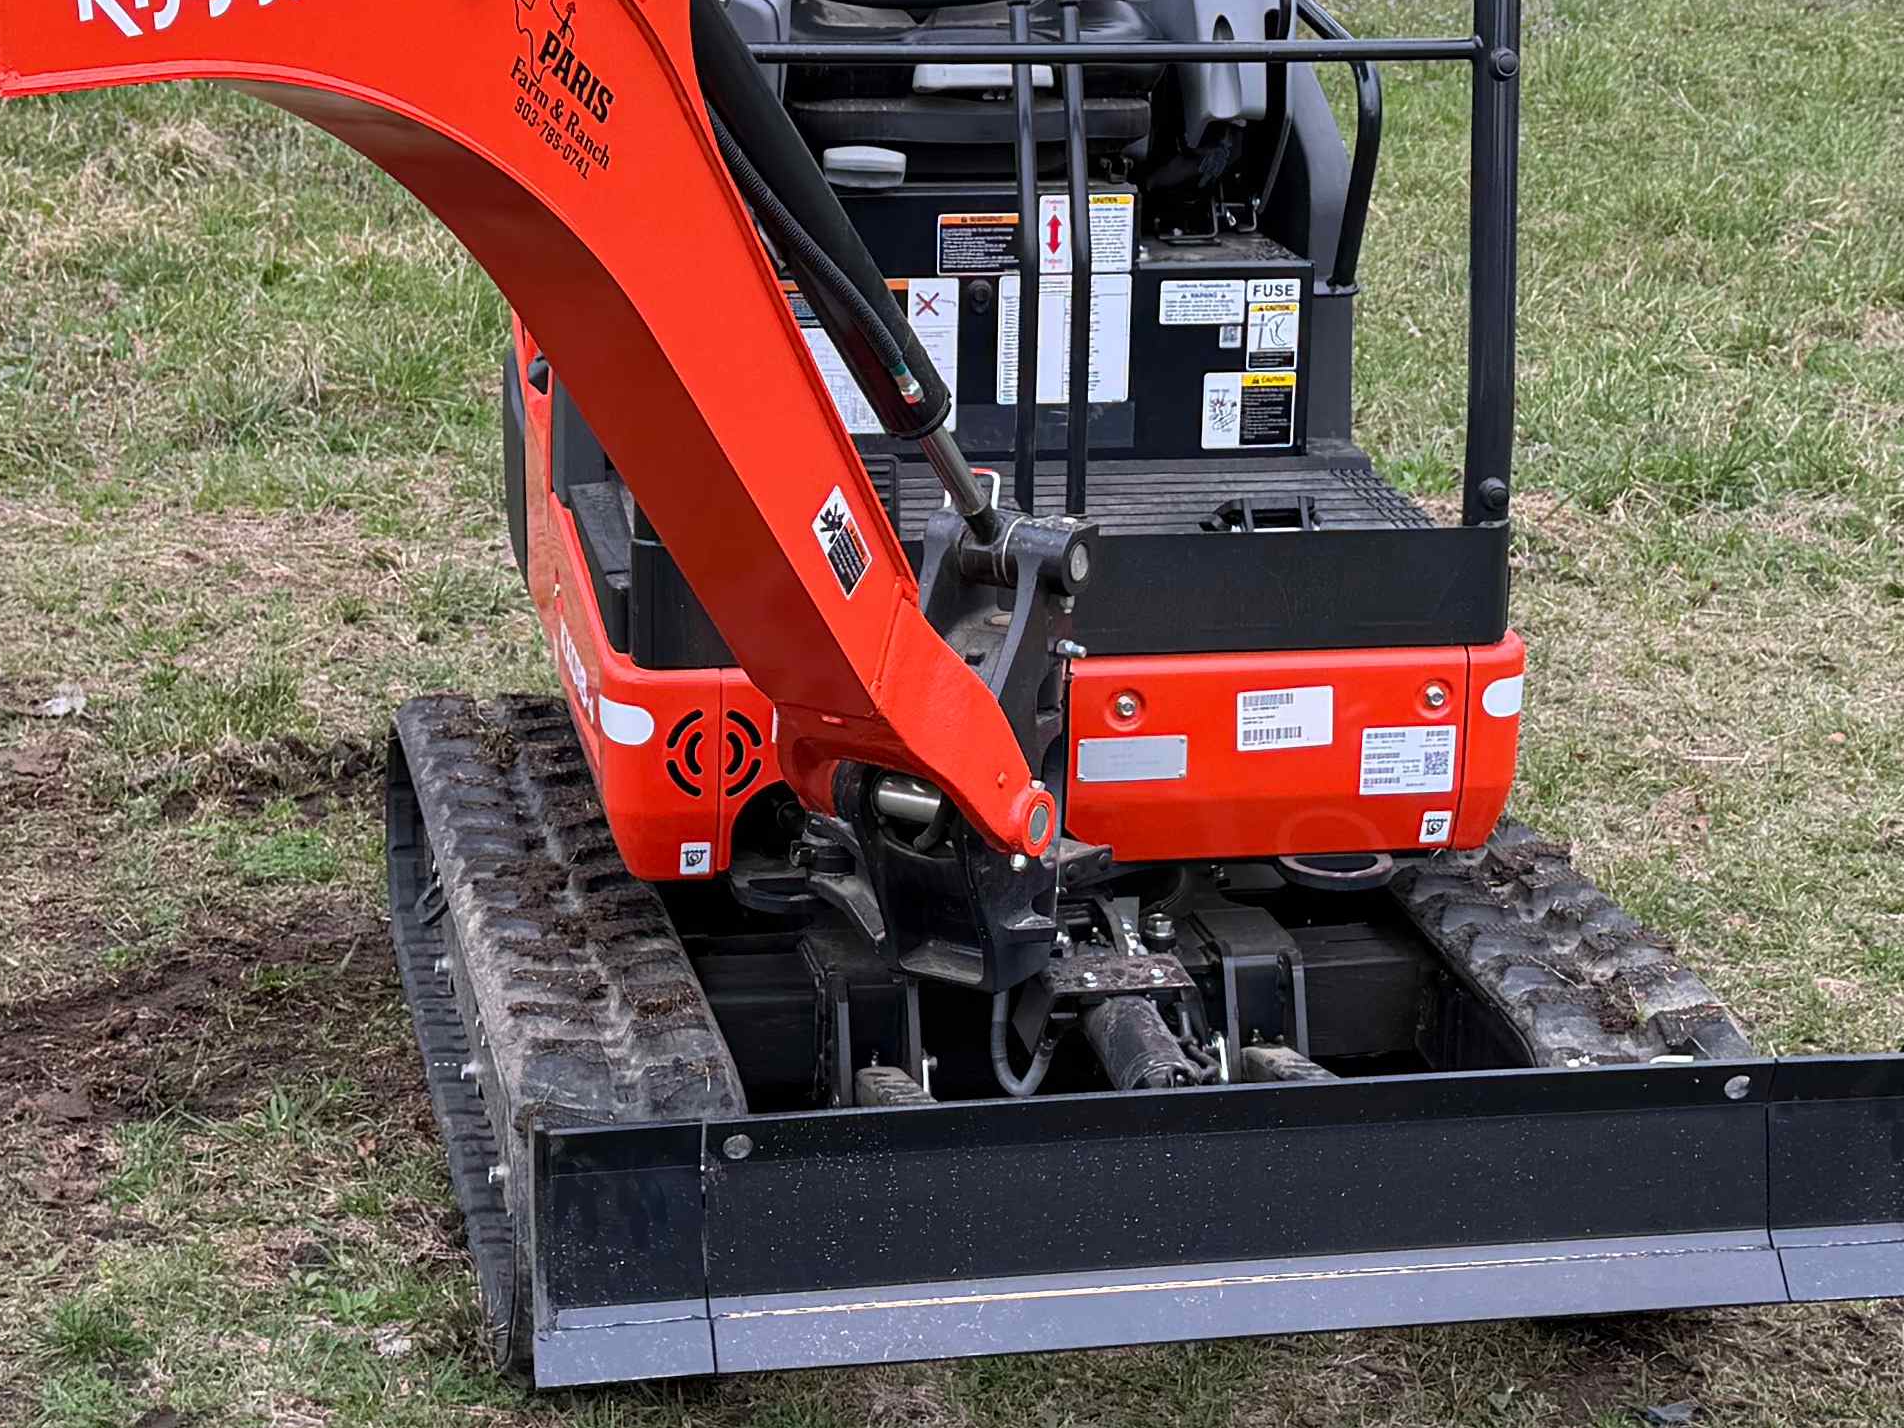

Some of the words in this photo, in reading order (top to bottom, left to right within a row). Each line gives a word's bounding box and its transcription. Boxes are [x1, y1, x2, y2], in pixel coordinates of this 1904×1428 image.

[510, 56, 549, 111] Farm
[549, 98, 565, 125] &
[564, 110, 611, 171] Ranch
[538, 28, 615, 124] PARIS
[514, 96, 591, 180] 903-785-0741
[1253, 284, 1296, 297] FUSE
